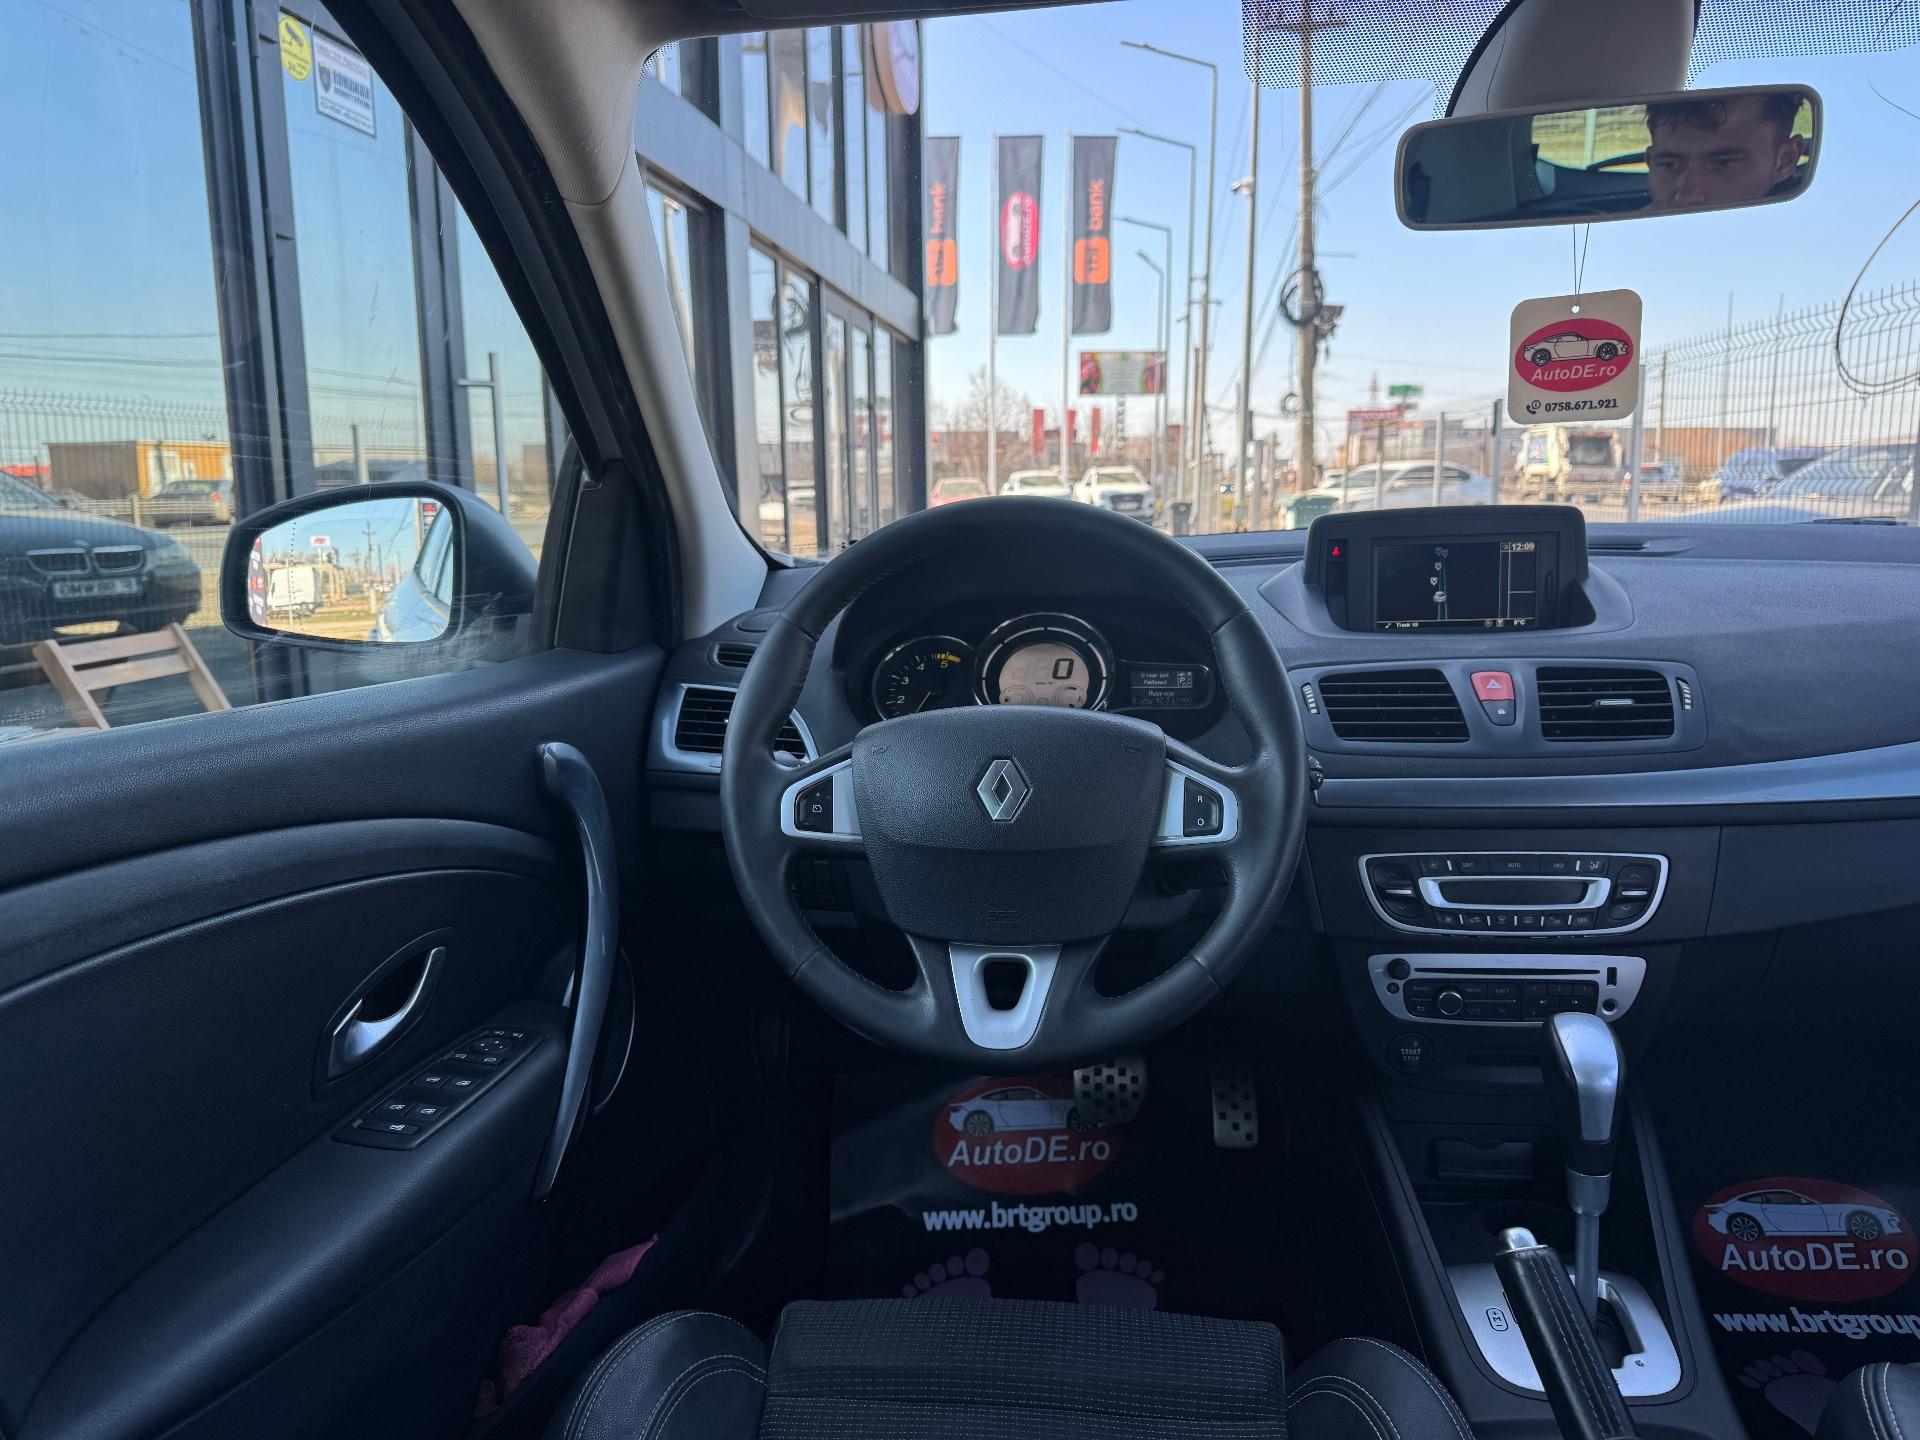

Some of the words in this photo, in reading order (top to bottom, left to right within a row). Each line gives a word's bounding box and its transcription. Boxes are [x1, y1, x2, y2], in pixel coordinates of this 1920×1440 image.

[1088, 179, 1105, 231] bank
[1531, 364, 1617, 382] AutoDE.ro
[1545, 399, 1618, 413] 0758.671.921
[916, 662, 925, 671] 4
[940, 660, 949, 669] 5
[1052, 658, 1074, 680] 0
[901, 676, 910, 685] 3
[896, 695, 905, 704] 2
[1197, 795, 1203, 803] R
[948, 1135, 1111, 1167] AutoDE.ro
[923, 1202, 1138, 1232] www.brtgroup.ro
[1721, 1242, 1909, 1271] AutoDE.ro
